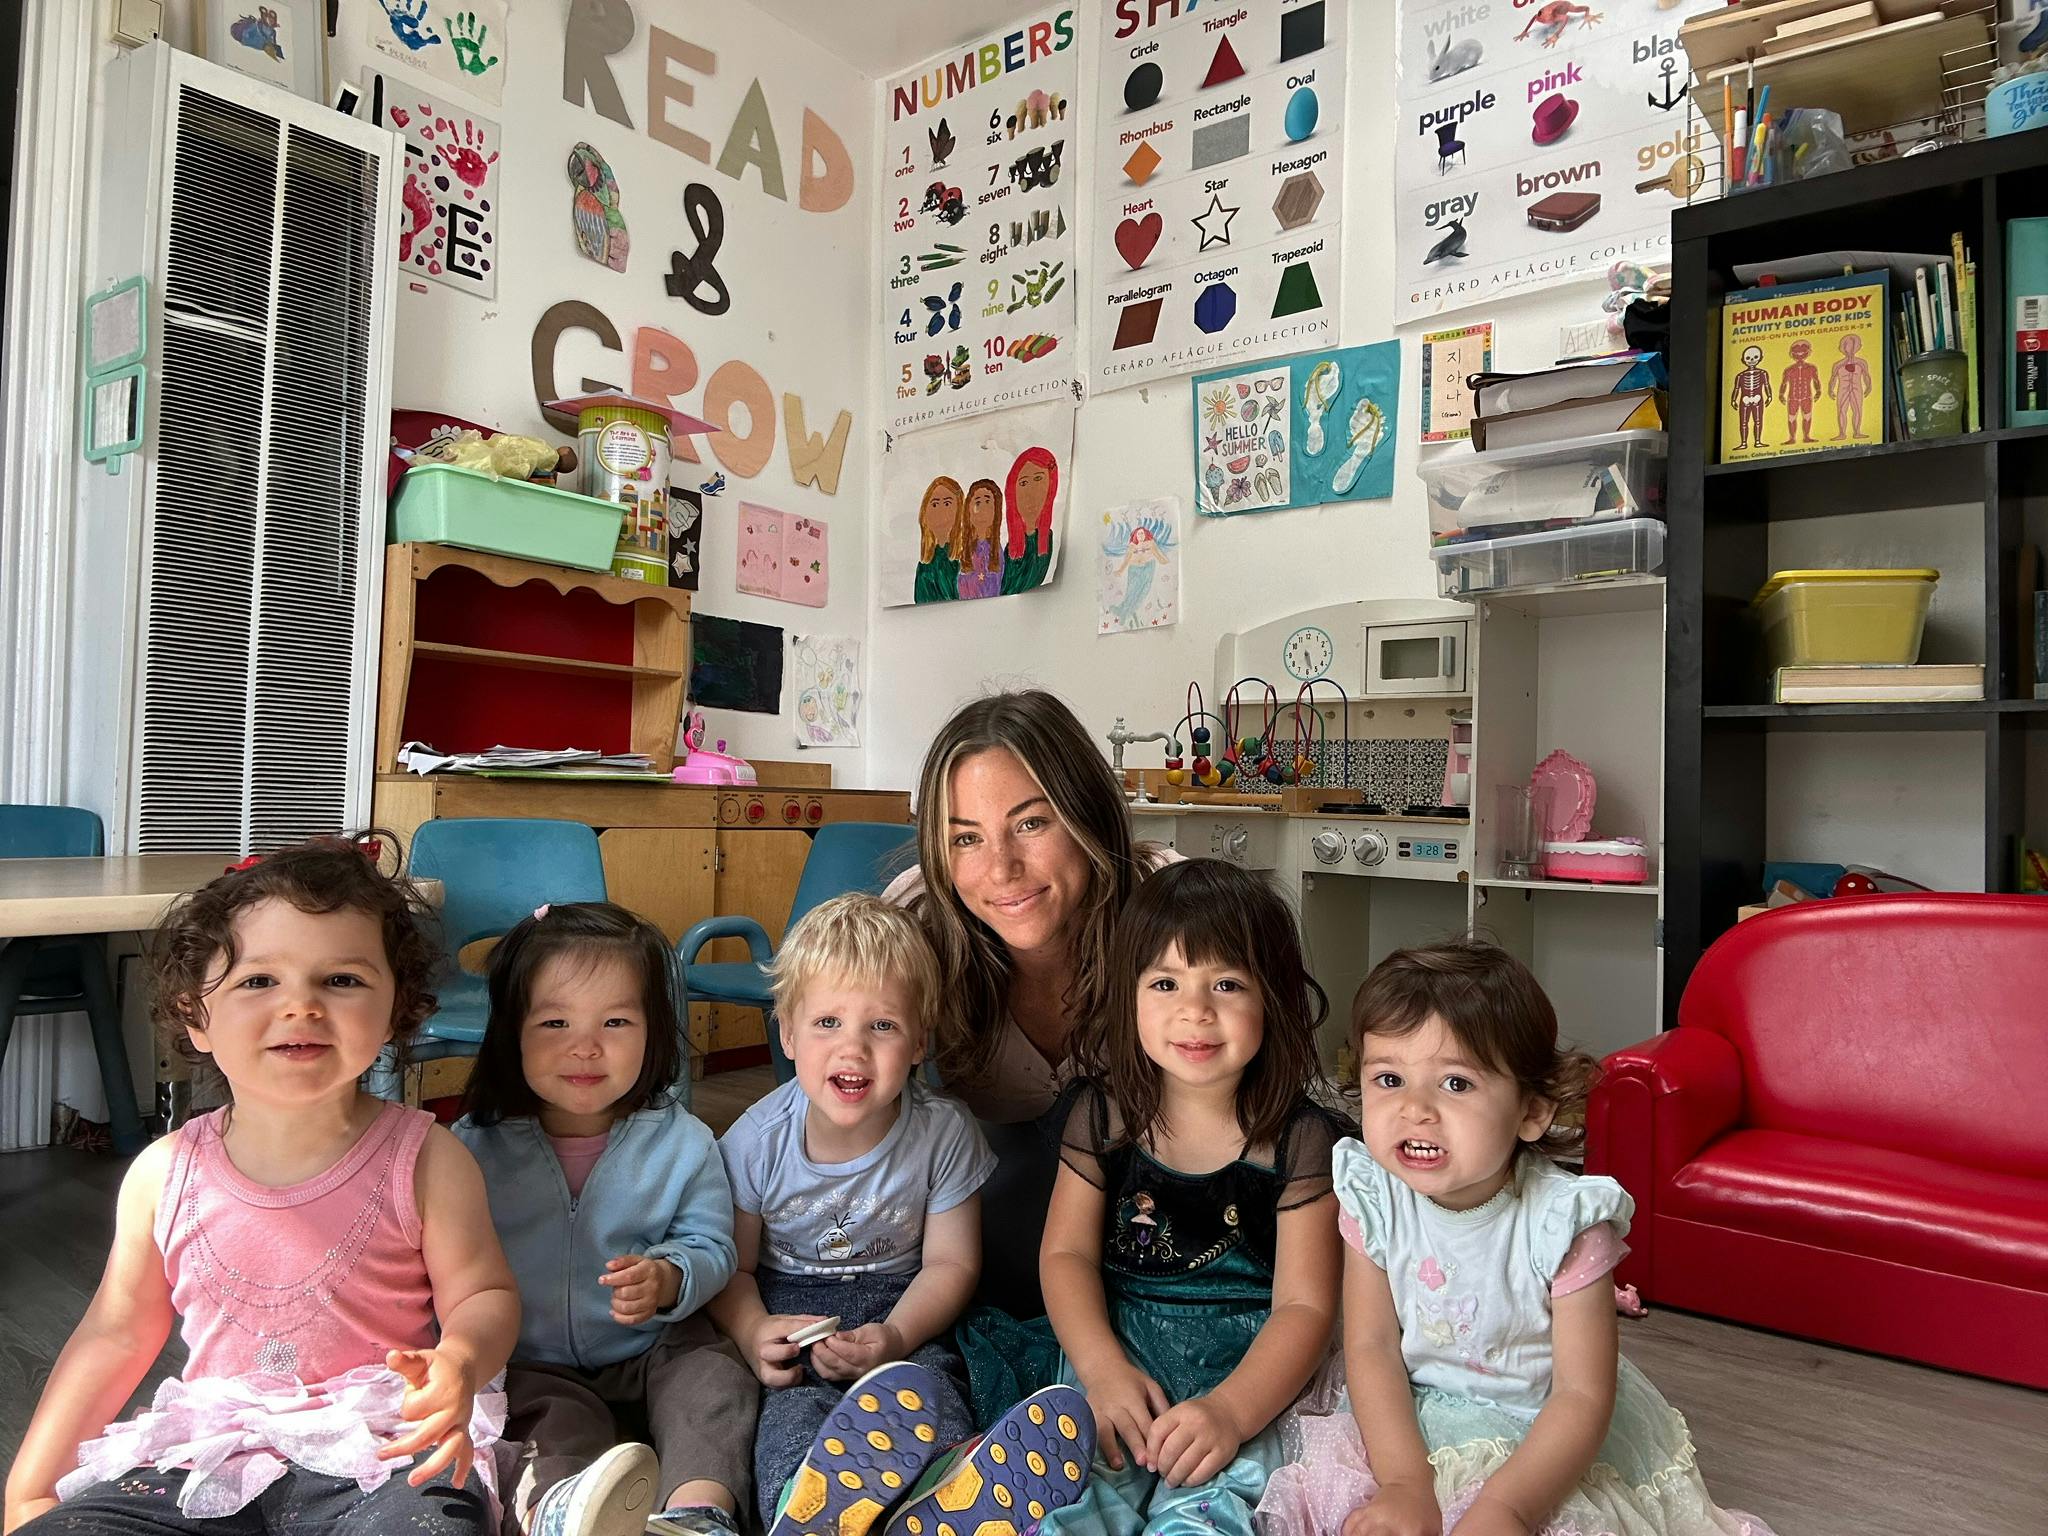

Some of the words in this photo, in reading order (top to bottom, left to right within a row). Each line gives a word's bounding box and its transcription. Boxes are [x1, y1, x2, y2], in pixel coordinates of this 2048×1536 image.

[1203, 8, 1248, 34] Triangle
[1424, 2, 1491, 39] white
[1130, 41, 1159, 60] Circle
[1632, 34, 1685, 65] blac
[893, 10, 1074, 122] NUMBERS
[1286, 69, 1316, 90] Oval
[1527, 61, 1584, 104] pink
[563, 0, 855, 213] READ
[1193, 94, 1251, 122] Rectangle
[1419, 89, 1496, 136] purple
[989, 108, 1001, 129] 6
[986, 131, 1002, 146] six
[1119, 119, 1174, 146] Rhombus
[902, 145, 910, 164] 1
[1636, 124, 1702, 172] gold
[895, 163, 915, 178] one
[1271, 150, 1327, 176] Hexagon
[987, 164, 1000, 186] 7
[1204, 177, 1229, 194] Star
[1516, 160, 1601, 198] brown
[978, 184, 1011, 205] seven
[899, 197, 909, 218] 2
[1123, 198, 1154, 217] Heart
[1424, 191, 1479, 226] gray
[893, 218, 915, 233] two
[989, 223, 1000, 245] 8
[664, 182, 731, 316] &
[980, 244, 1008, 265] eight
[1272, 239, 1324, 264] Trapezoid
[1590, 234, 1667, 261] COLLEC
[900, 255, 911, 275] 3
[1194, 265, 1239, 284] Octagon
[890, 273, 920, 290] three
[987, 279, 999, 300] 9
[1107, 281, 1172, 306] Parallelogram
[900, 308, 912, 328] 4
[981, 302, 1005, 318] nine
[1731, 302, 1809, 326] HUMAN
[1813, 294, 1873, 315] BODY
[1232, 319, 1330, 348] COLLECTION
[1732, 321, 1782, 336] ACTIVITY
[1784, 316, 1816, 329] BOOK
[1819, 314, 1842, 325] FOR
[1844, 310, 1872, 322] KIDS
[894, 329, 918, 345] four
[1738, 333, 1782, 345] HANDS-ON
[1799, 329, 1816, 337] FOR
[1816, 325, 1850, 334] GRADES
[983, 335, 1005, 360] 10
[901, 363, 913, 383] 5
[984, 360, 1003, 375] ten
[993, 377, 1069, 403] COLLECTION
[1926, 373, 1951, 387] SPACE
[531, 300, 852, 496] GROW
[896, 385, 917, 400] five
[1225, 422, 1258, 441] HELLO
[1221, 437, 1267, 457] SUMMER
[1416, 844, 1439, 856] 3:28
